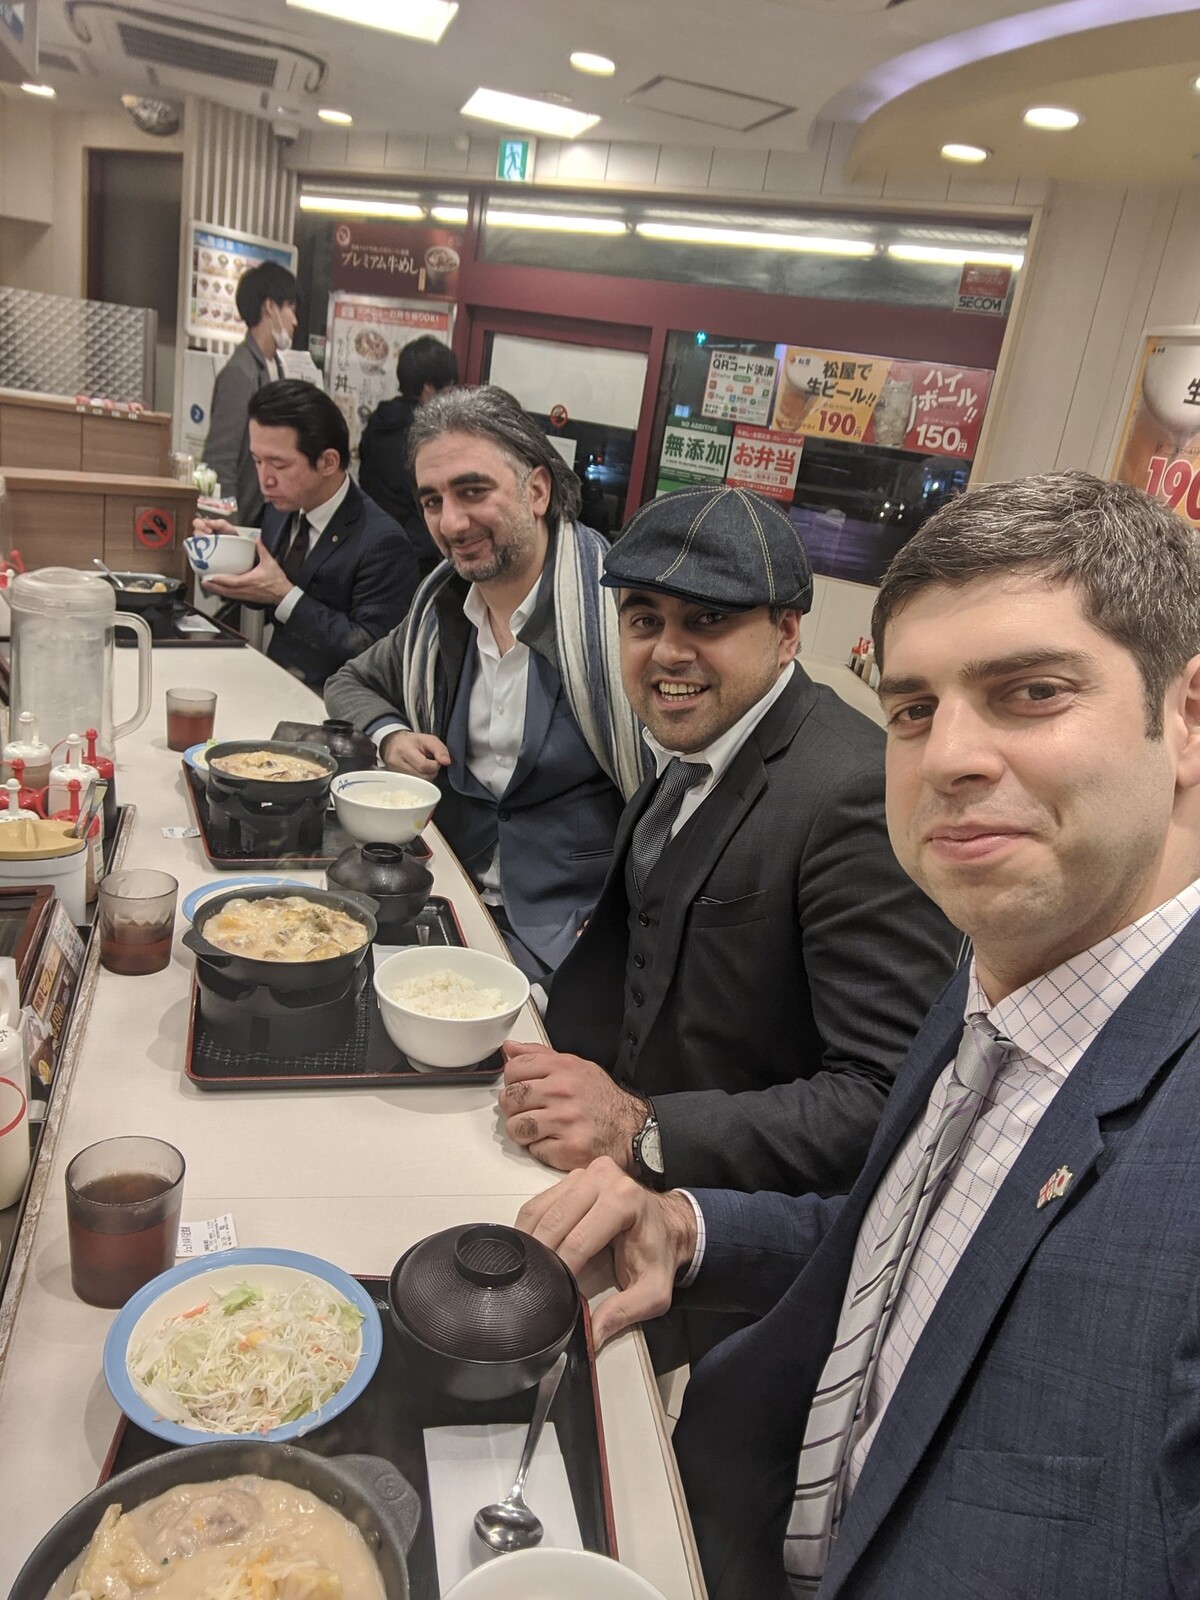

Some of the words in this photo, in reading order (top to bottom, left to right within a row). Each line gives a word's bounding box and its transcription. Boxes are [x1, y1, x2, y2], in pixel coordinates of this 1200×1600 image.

[341, 251, 419, 275] プレミアム牛めし
[958, 295, 1002, 311] SECOM
[712, 358, 775, 378] QRコード決済
[823, 361, 873, 381] 松屋で
[923, 369, 964, 393] ハイ
[681, 420, 690, 428] NO
[691, 422, 718, 433] ADDITIVE
[916, 423, 968, 453] 150円
[664, 433, 727, 466] 無添加
[733, 442, 797, 475] お弁当
